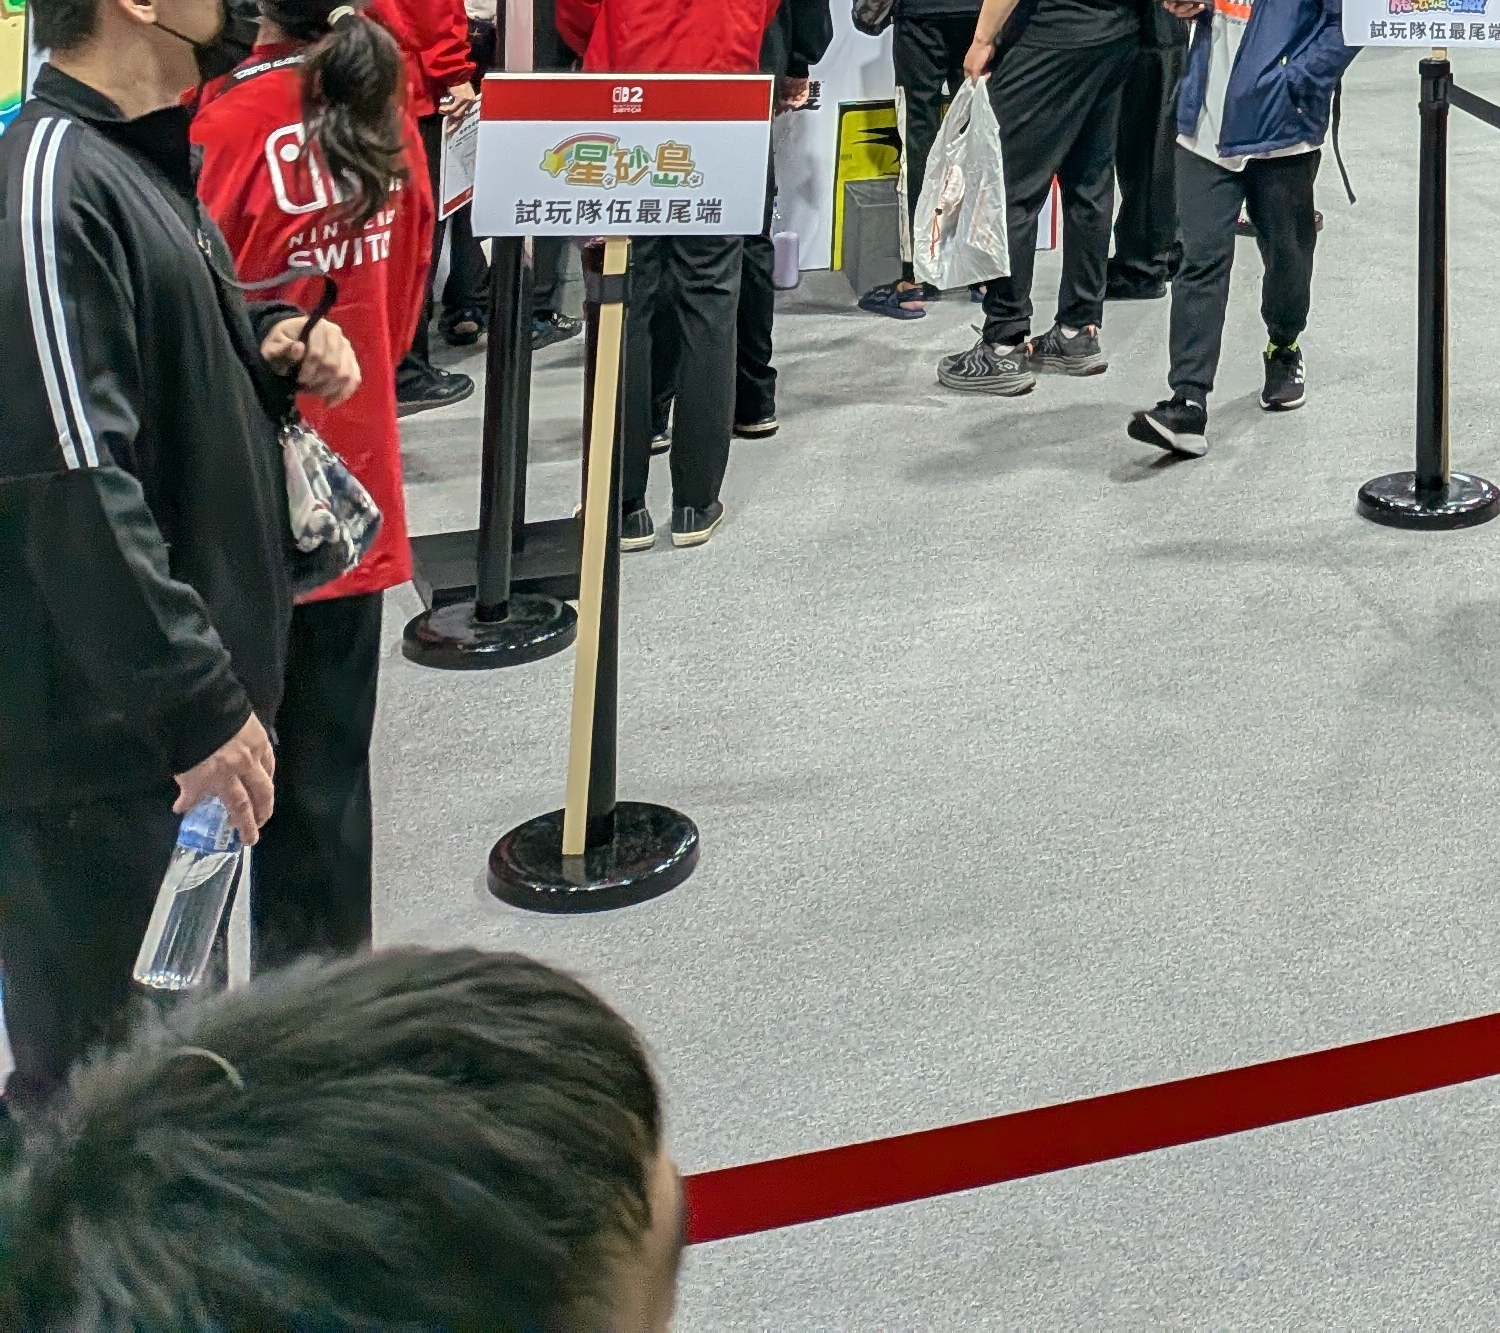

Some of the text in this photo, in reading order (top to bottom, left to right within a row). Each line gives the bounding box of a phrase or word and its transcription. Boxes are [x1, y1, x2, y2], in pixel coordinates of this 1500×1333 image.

[630, 86, 643, 103] 2
[566, 140, 696, 187] 星砂島
[515, 197, 723, 225] 試玩隊伍最尾端
